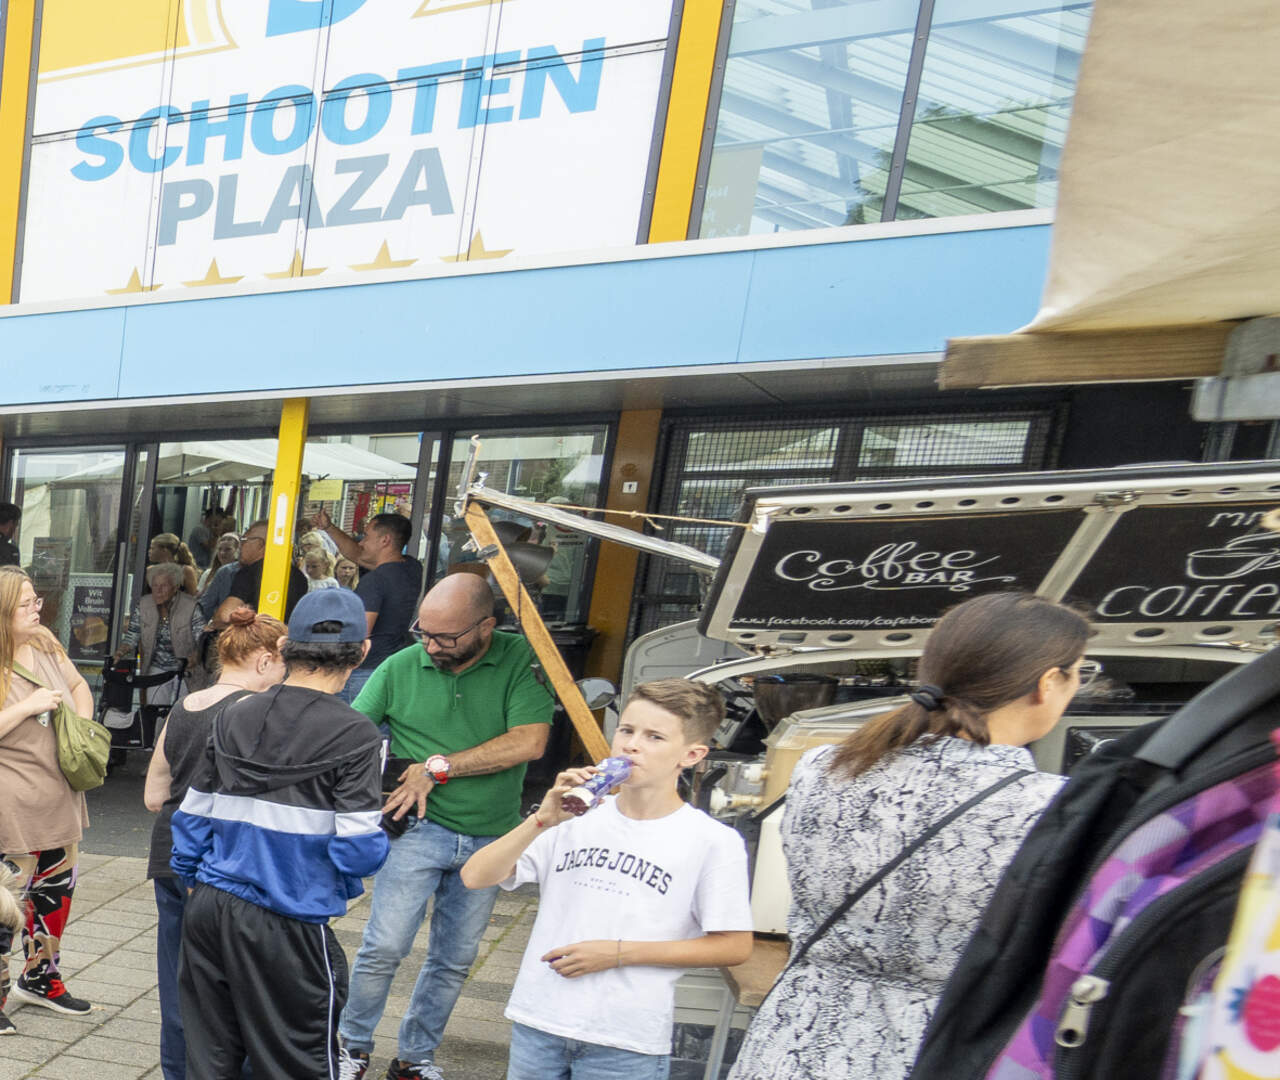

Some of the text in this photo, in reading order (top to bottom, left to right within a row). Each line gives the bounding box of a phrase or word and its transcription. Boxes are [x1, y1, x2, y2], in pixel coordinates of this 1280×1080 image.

[70, 36, 606, 182] SCHOOTEN
[157, 147, 454, 246] PLAZA
[775, 541, 1000, 581] Coffee
[901, 570, 977, 585] BAR
[1096, 583, 1280, 617] COFFE
[555, 847, 673, 895] JACK&JONES
